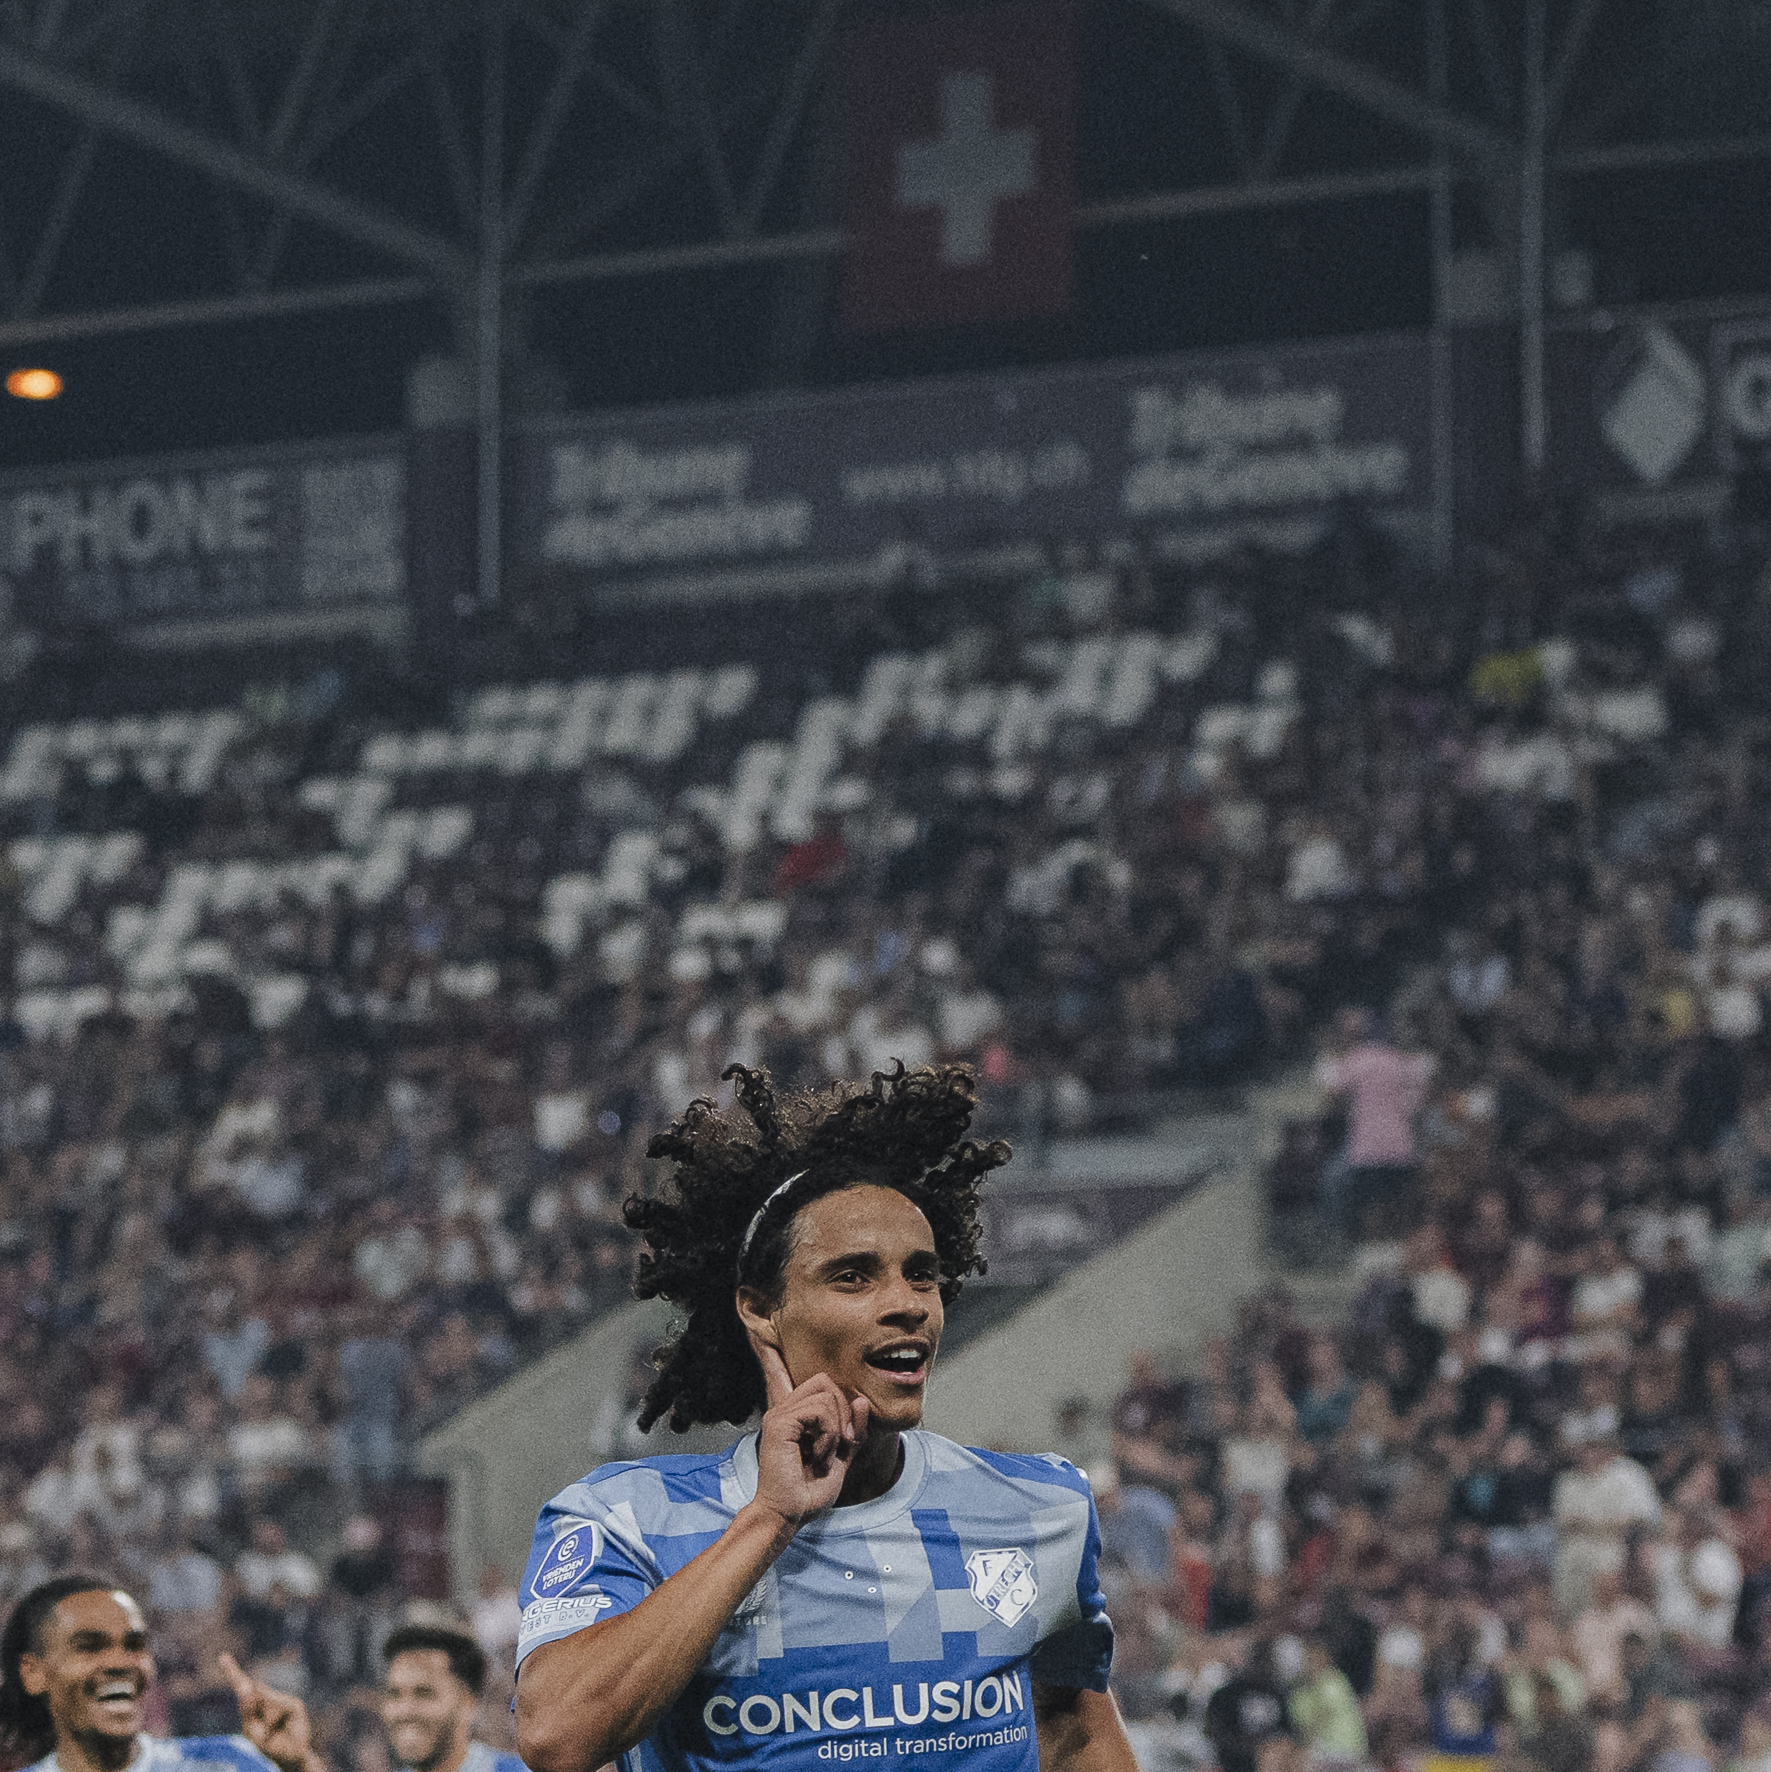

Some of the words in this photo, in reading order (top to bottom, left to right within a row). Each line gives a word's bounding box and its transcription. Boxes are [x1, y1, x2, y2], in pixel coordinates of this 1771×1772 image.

[983, 1559, 1026, 1611] UTRECHT
[1010, 1588, 1024, 1606] C
[702, 1669, 1025, 1735] CONCLUSION
[817, 1737, 888, 1762] digital
[895, 1725, 1028, 1756] transformation
